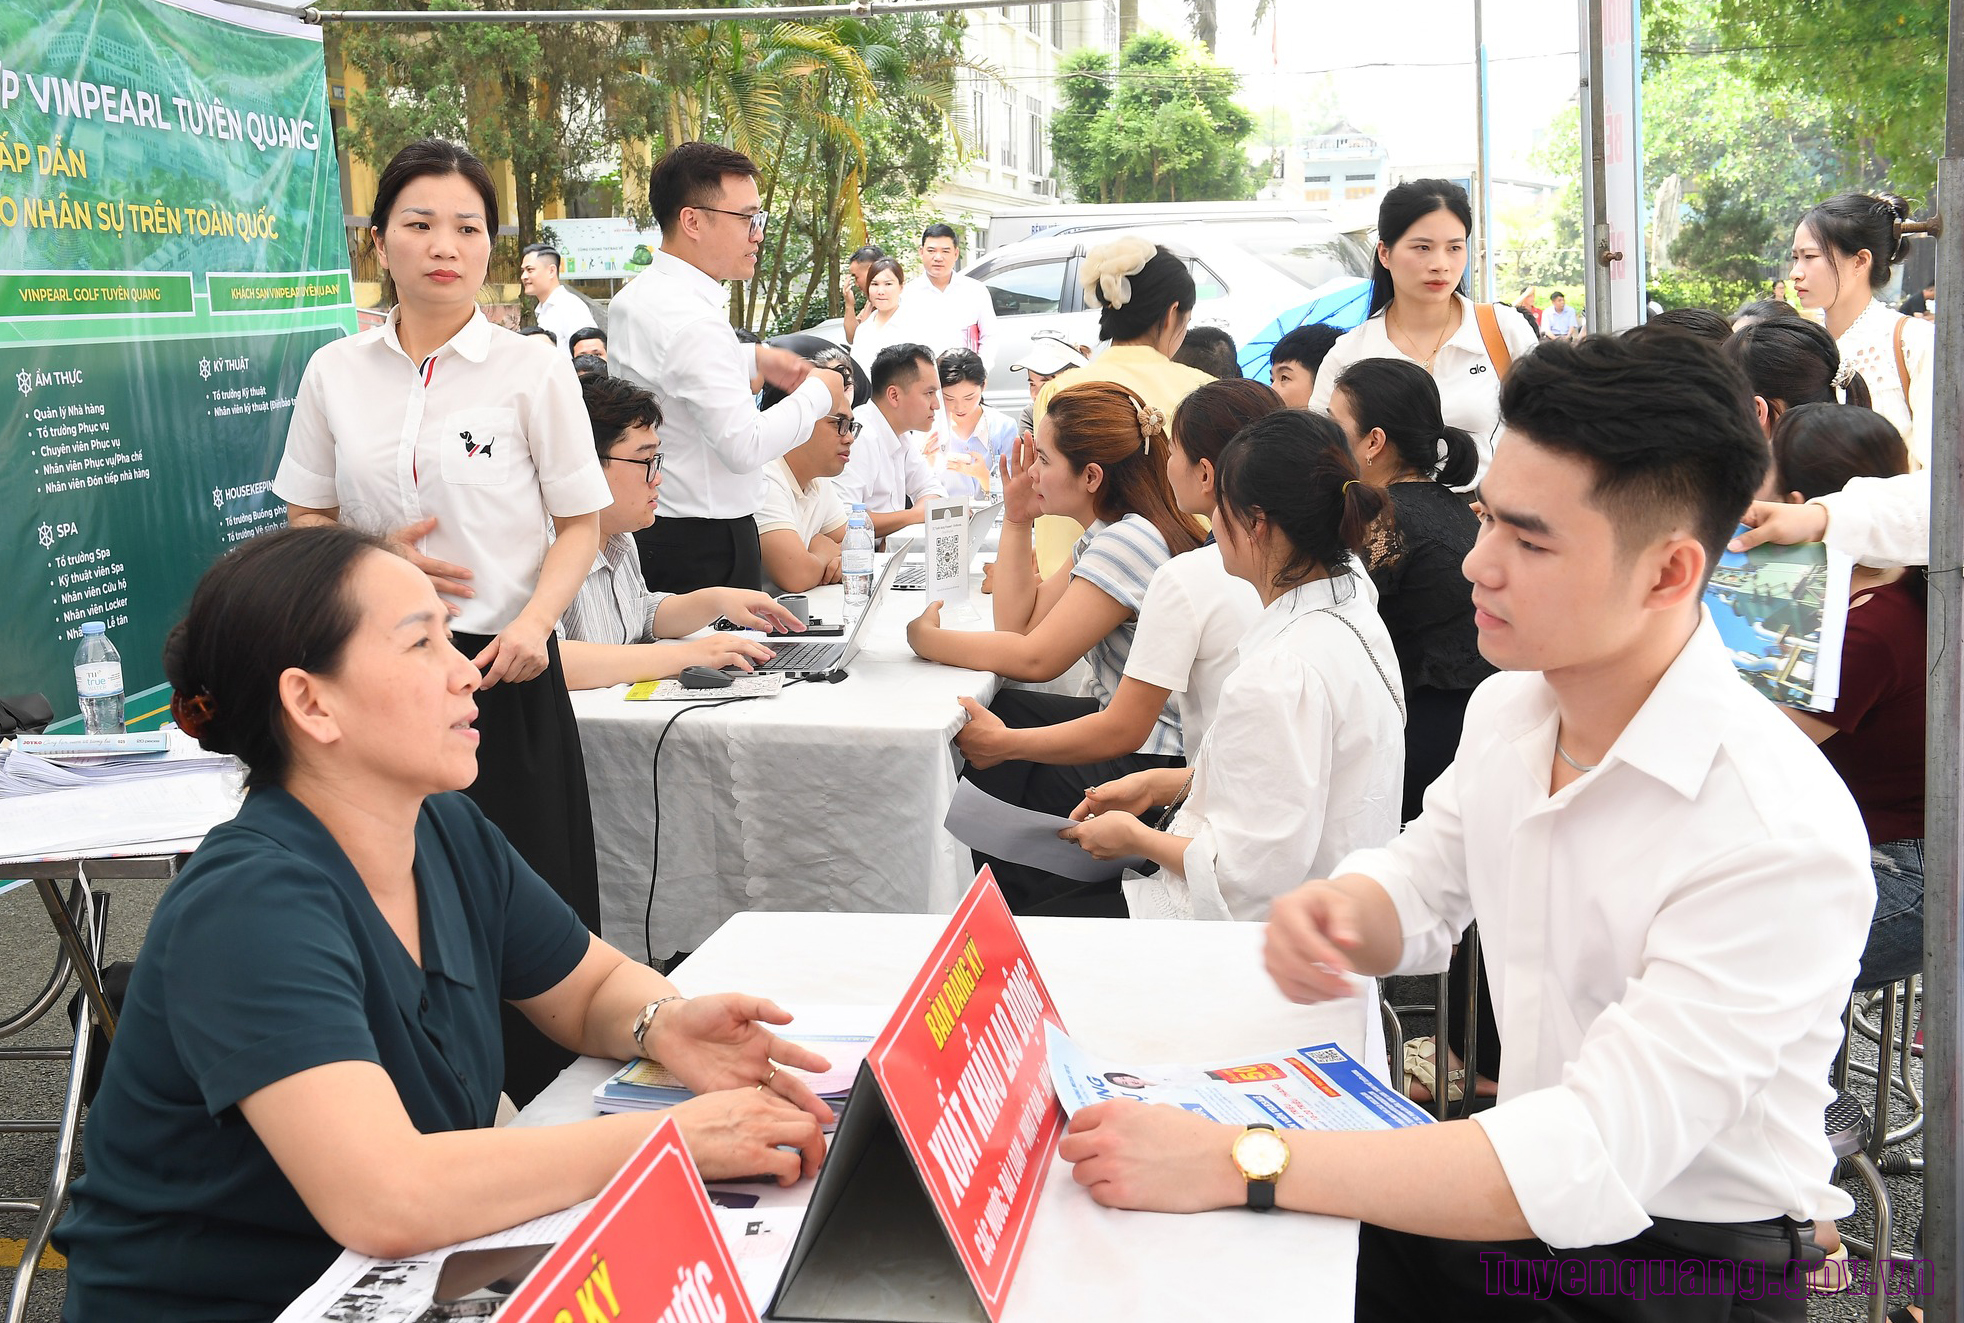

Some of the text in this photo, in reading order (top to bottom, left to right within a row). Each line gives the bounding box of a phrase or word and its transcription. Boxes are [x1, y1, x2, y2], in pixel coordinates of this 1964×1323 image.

[0, 60, 319, 151] P VINPEARL TUYÊN QUANG
[37, 134, 87, 178] DẪN
[23, 192, 93, 231] NHÂN
[96, 199, 126, 239] SỰ
[128, 199, 182, 235] TRÊN
[184, 204, 235, 238] TOÀN
[236, 206, 279, 243] QUỐC
[18, 284, 161, 303] VINPEARL GOLF TUYÊN QUANG
[231, 285, 255, 300] KHÁCH
[213, 355, 250, 373] KỸ THUẬT
[1469, 363, 1487, 375] alo
[35, 368, 83, 388] ẨM THỰC
[249, 385, 267, 398] thuật
[33, 402, 105, 422] Quản lý Nhà hàng
[214, 406, 231, 418] Nhân
[231, 404, 244, 416] viên
[252, 401, 270, 413] thuật
[78, 421, 99, 435] Phục
[99, 421, 110, 433] vụ
[40, 437, 121, 458] Chuyên viên Phục vụ
[43, 460, 65, 476] Nhân
[65, 458, 83, 472] viên
[84, 456, 105, 471] Phục
[130, 448, 143, 461] chế
[45, 467, 150, 494] Nhân viên Đón tiếp nhà hàng
[225, 480, 275, 501] HOUSEKEEPIN
[56, 521, 79, 538] SPA
[264, 521, 279, 534] sinh
[95, 547, 111, 561] Spa
[58, 562, 125, 588] Kỹ thuật viên Spa
[61, 577, 128, 605] Nhân viên Cứu hộ
[63, 597, 129, 624] Nhân viên Locker
[66, 626, 84, 641] Nhâ
[116, 613, 129, 627] tân
[87, 678, 107, 686] true
[923, 929, 985, 1053] BÀN ĐĂNG KÝ
[927, 957, 1044, 1208] XUẤT KHẨU LAO ĐỘNG
[1233, 1066, 1267, 1081] 50
[973, 1218, 996, 1267] CÁC
